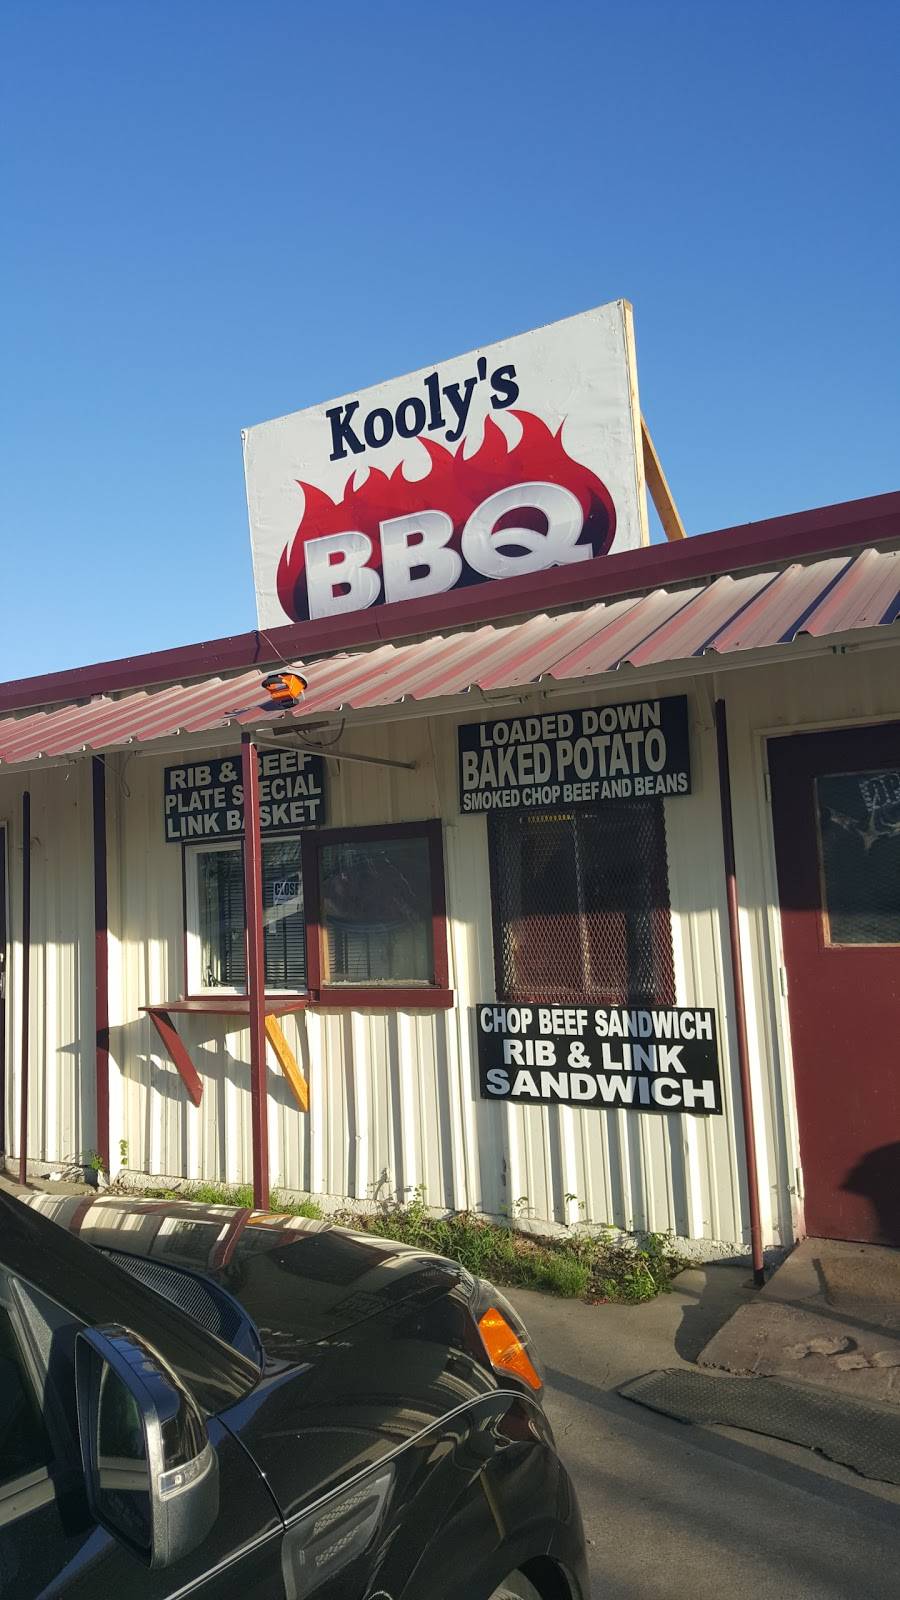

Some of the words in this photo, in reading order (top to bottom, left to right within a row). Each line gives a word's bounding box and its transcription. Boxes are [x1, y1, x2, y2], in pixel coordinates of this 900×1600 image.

[325, 356, 520, 461] Kooly's
[303, 480, 594, 620] BBQ
[480, 713, 574, 747] LOADED
[582, 701, 661, 735] DOWN
[170, 766, 212, 790] RIB
[218, 761, 238, 783] &
[257, 751, 312, 777] EEF
[462, 742, 551, 791] BAKED
[556, 728, 667, 782] POTATO
[165, 786, 226, 815] PLATE
[231, 773, 322, 806] SECIAL
[463, 788, 520, 811] SMOKED
[522, 785, 560, 805] CHOP
[563, 780, 600, 803] BEEF
[600, 778, 632, 799] AND
[634, 772, 688, 796] BEANS
[167, 811, 221, 838] LINK
[226, 798, 321, 831] BSKET
[480, 1007, 533, 1034] CHOP
[538, 1008, 588, 1036] BEEF
[594, 1009, 713, 1040] SANDWICH
[502, 1038, 557, 1067] RIB
[567, 1041, 592, 1069] &
[601, 1042, 687, 1074] LINK
[486, 1068, 716, 1109] SANDWICH
